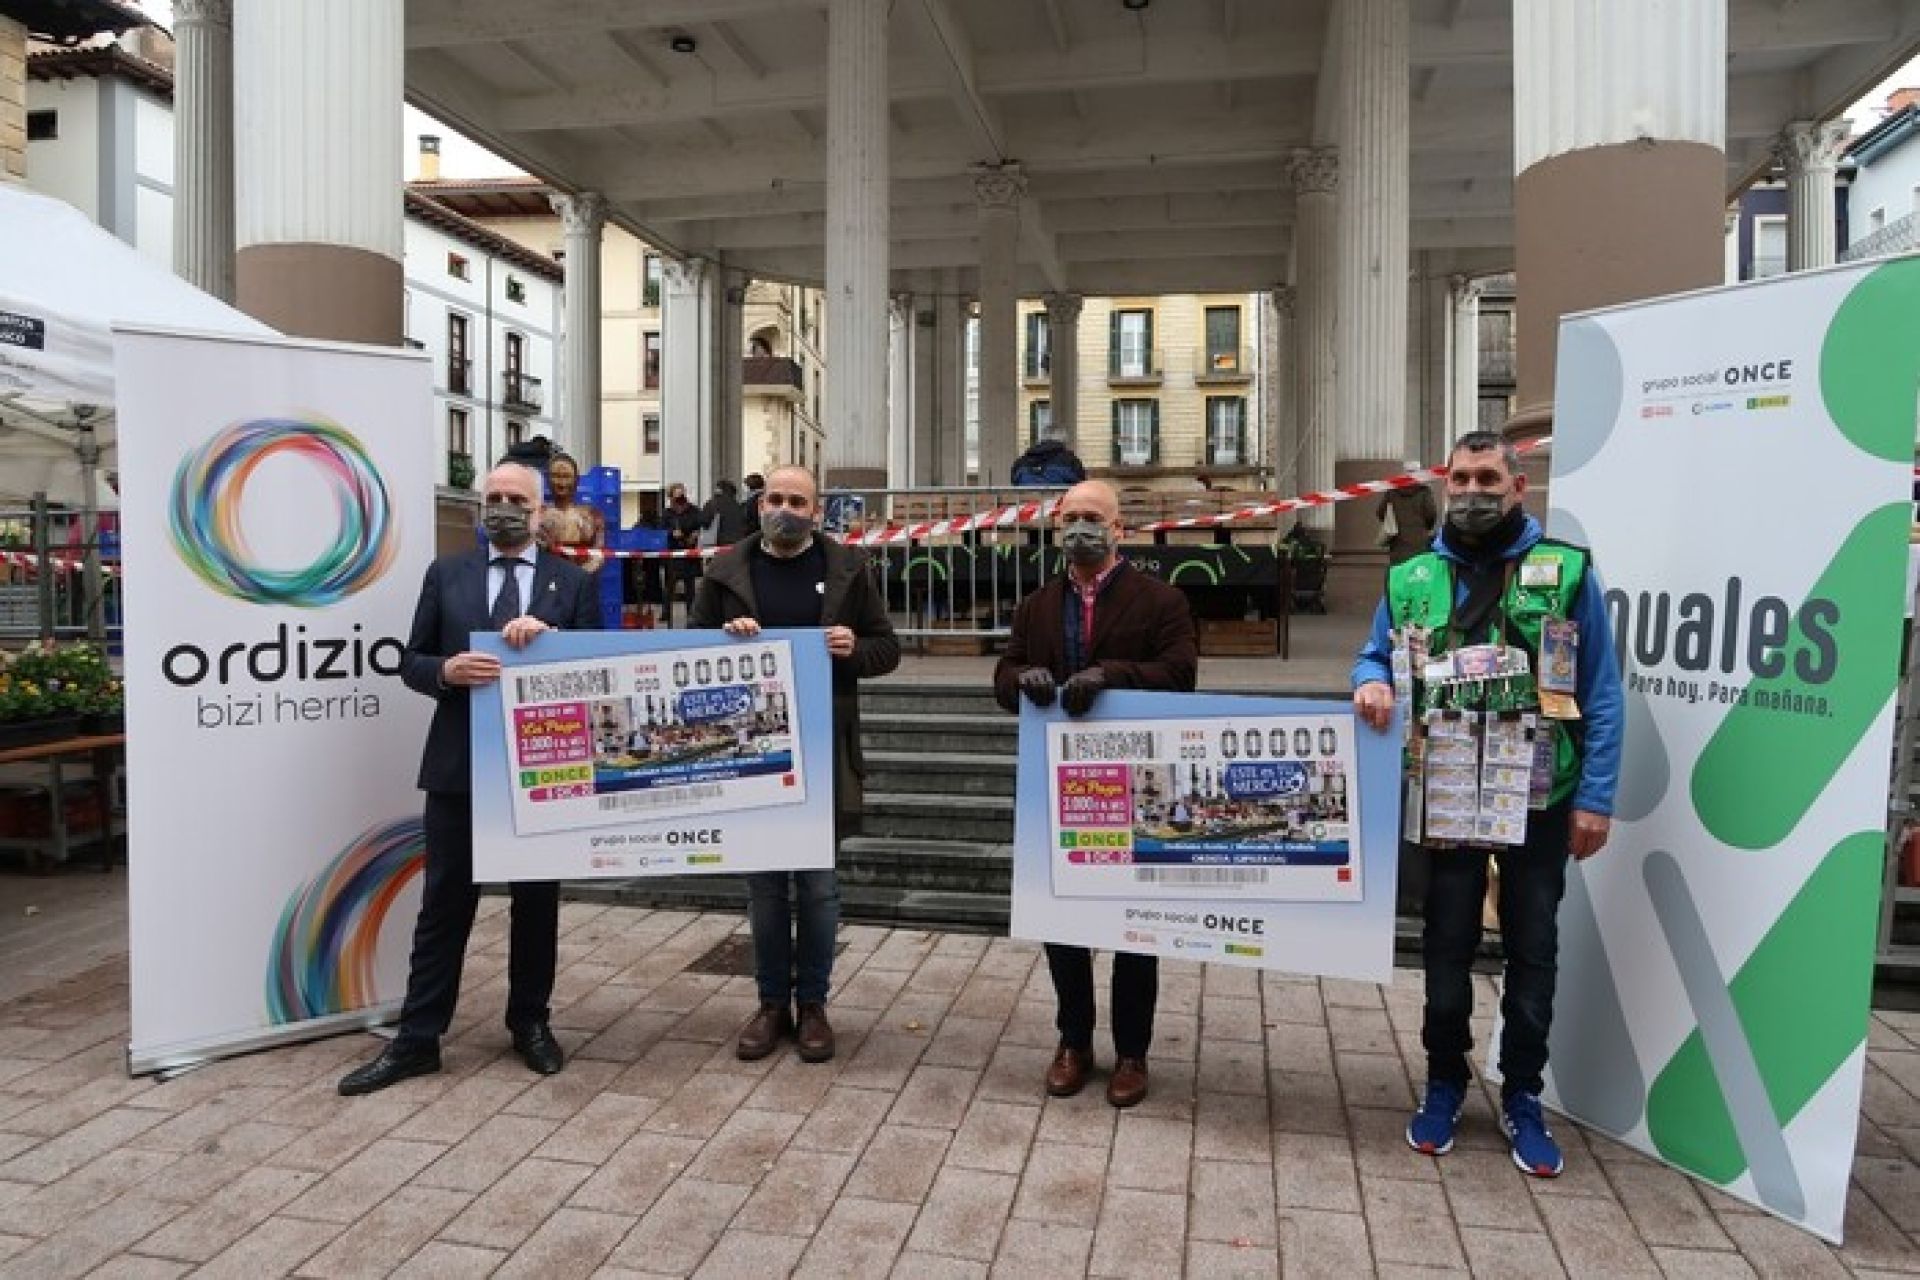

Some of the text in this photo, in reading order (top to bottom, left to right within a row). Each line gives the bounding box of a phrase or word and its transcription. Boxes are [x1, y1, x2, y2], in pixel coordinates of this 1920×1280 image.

[1642, 359, 1792, 393] grupo social ONCE
[1628, 672, 1833, 718] Para hoy. Para mañana.
[198, 686, 380, 729] bizi herria
[540, 765, 590, 785] ONCE
[667, 829, 723, 845] ONCE
[1079, 833, 1128, 847] ONCE
[1204, 914, 1265, 934] ONCE
